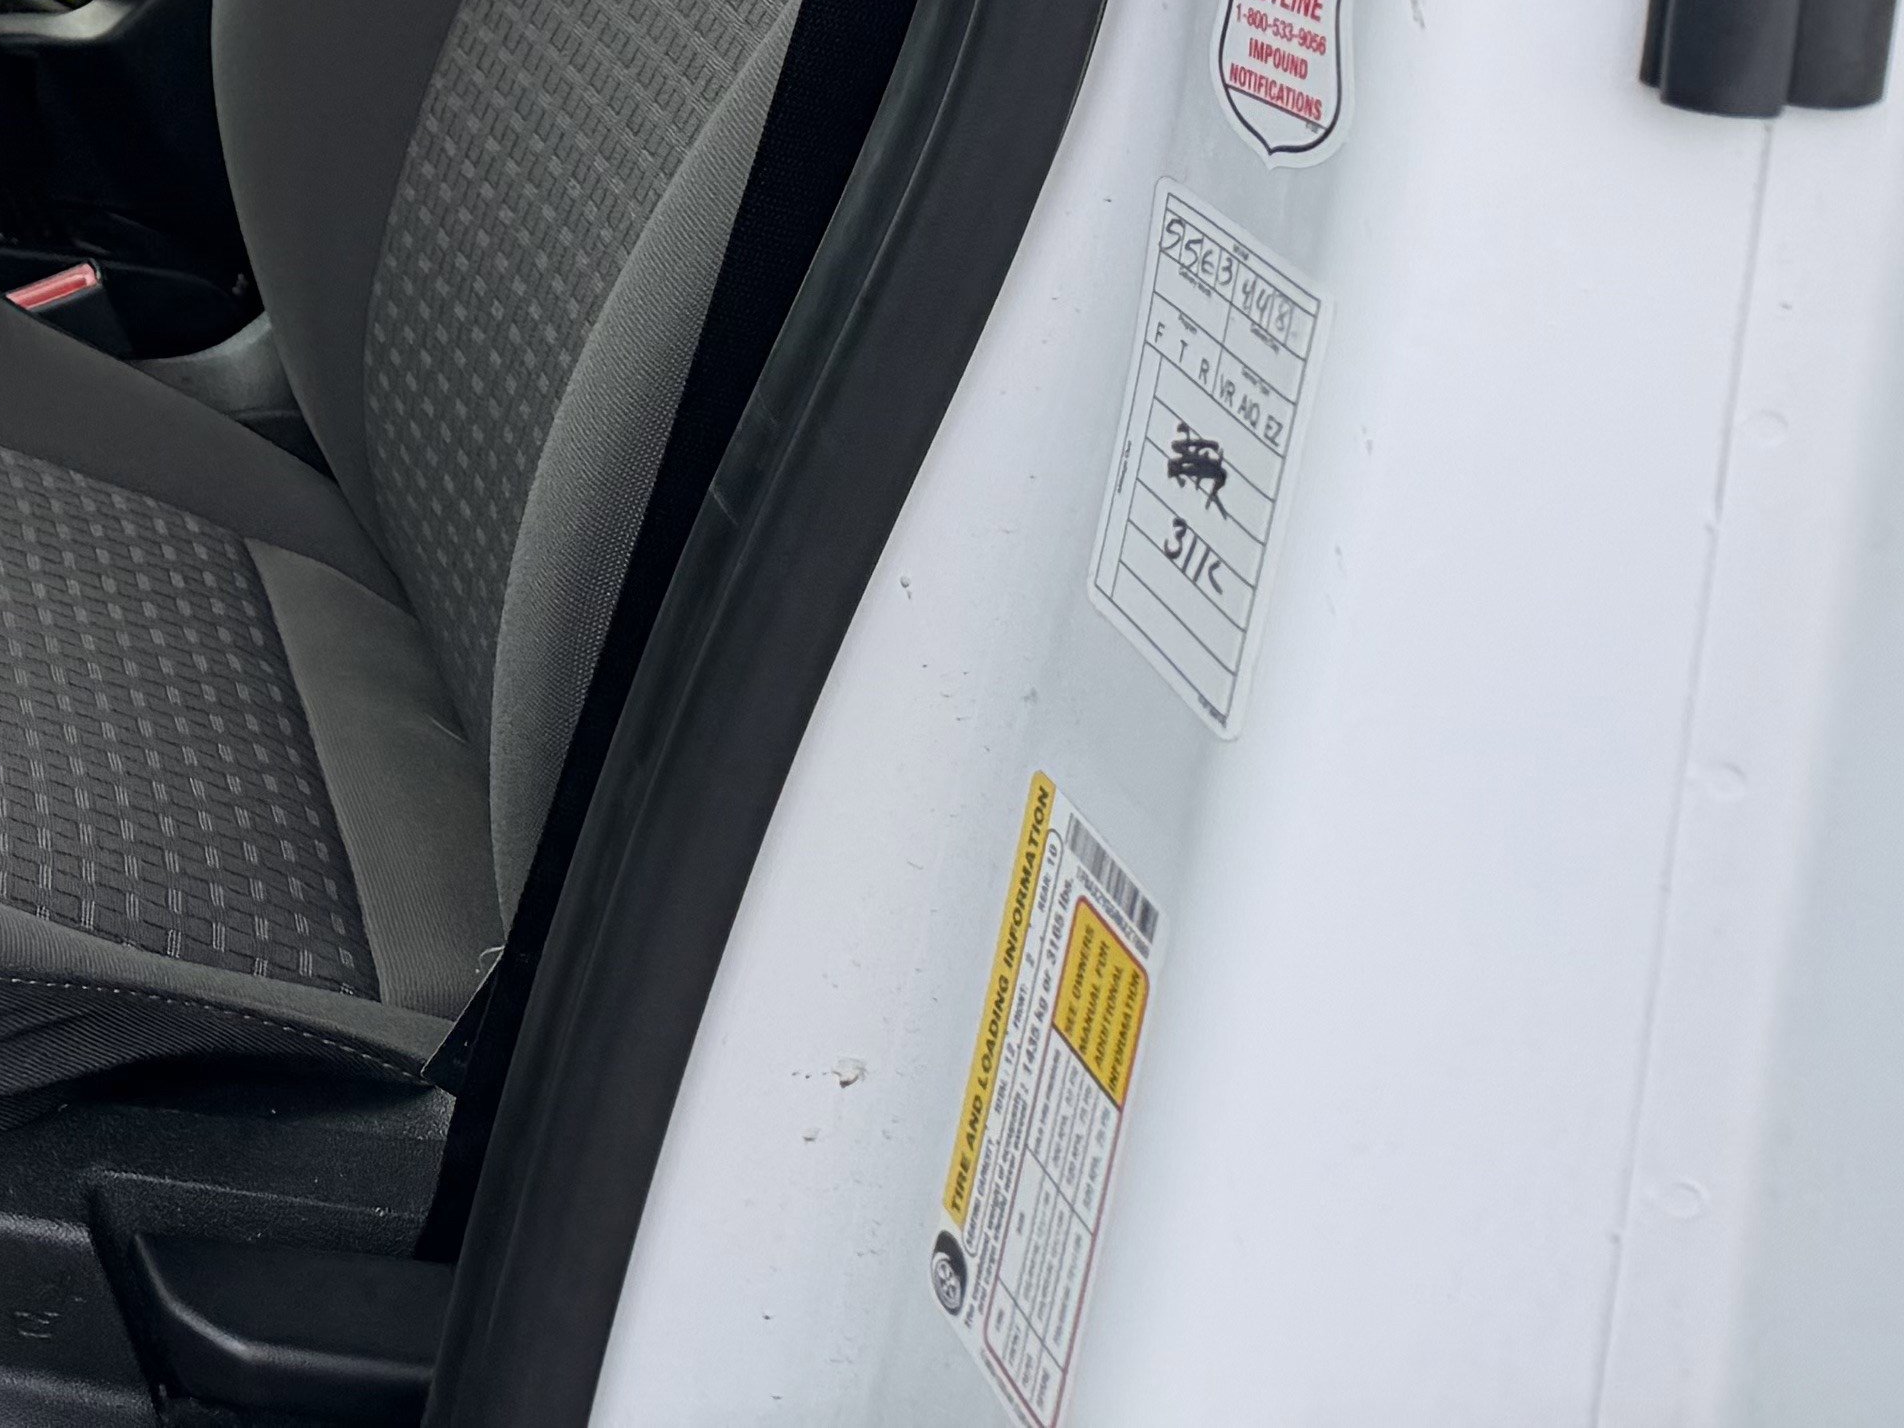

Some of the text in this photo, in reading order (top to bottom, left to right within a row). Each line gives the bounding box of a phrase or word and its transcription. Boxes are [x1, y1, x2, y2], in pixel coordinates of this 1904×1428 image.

[1248, 37, 1309, 80] IMPOUND
[1229, 62, 1323, 121] NOTIFICATIONS
[951, 785, 1050, 1213] TIRE AND LOADING INFORMATION
